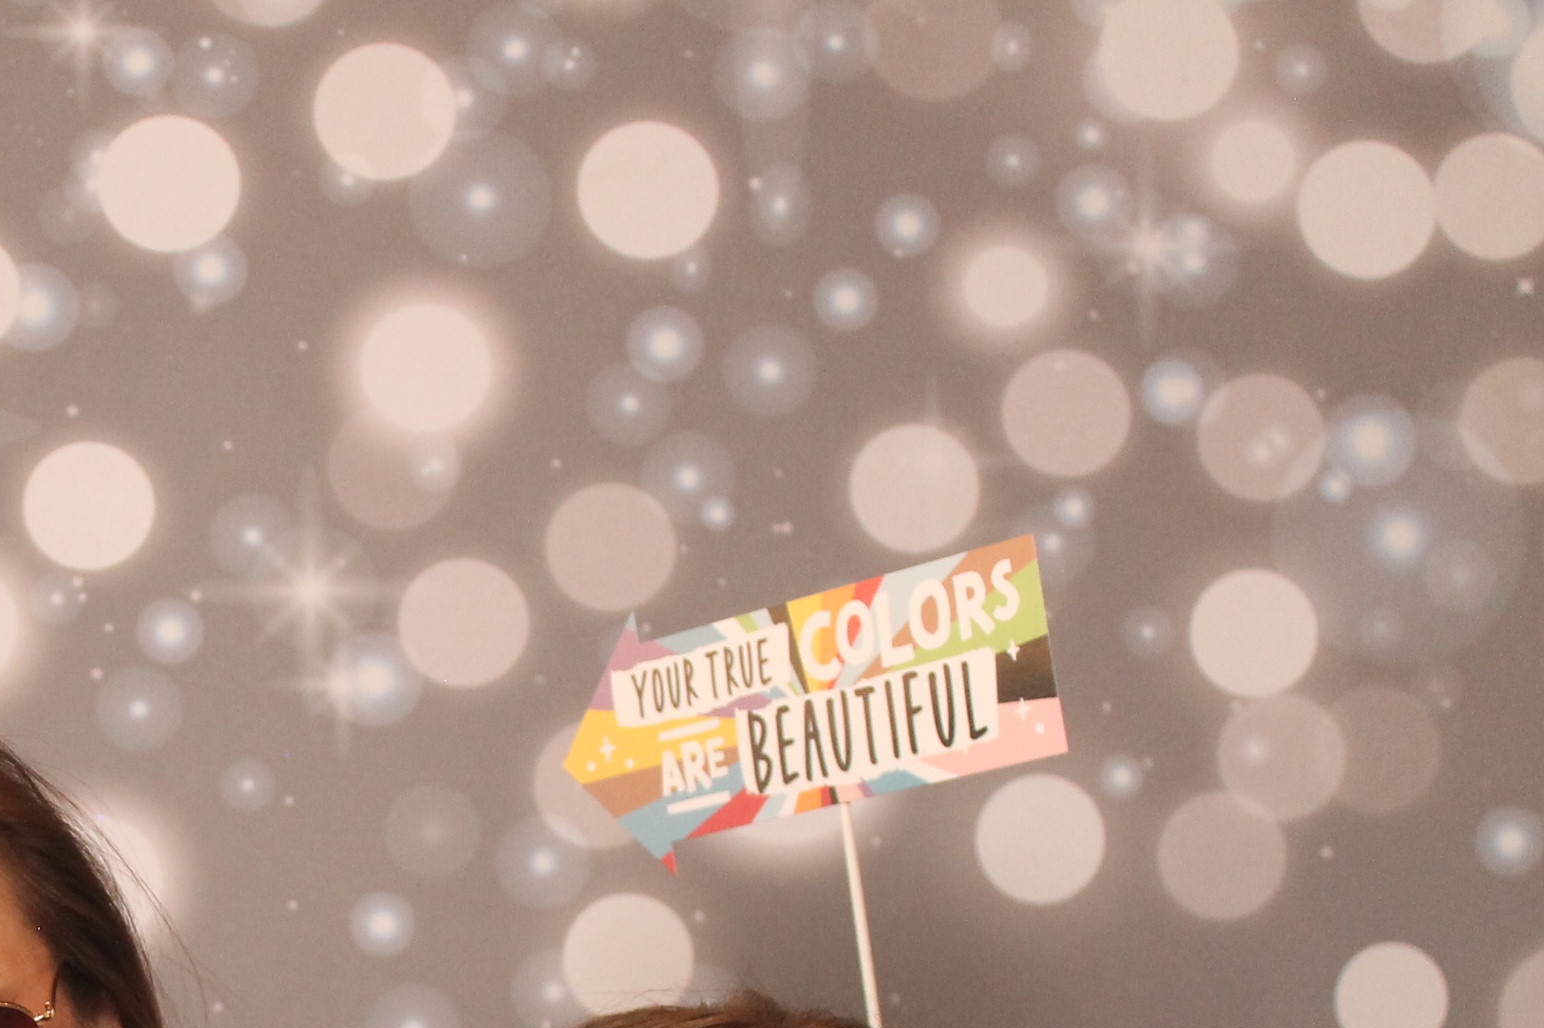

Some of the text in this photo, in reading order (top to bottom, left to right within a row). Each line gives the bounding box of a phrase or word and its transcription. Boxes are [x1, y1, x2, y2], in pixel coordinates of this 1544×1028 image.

[631, 558, 1021, 719] YOUR TRUE COLORS
[661, 660, 988, 797] ARE BEAUTIFUL
